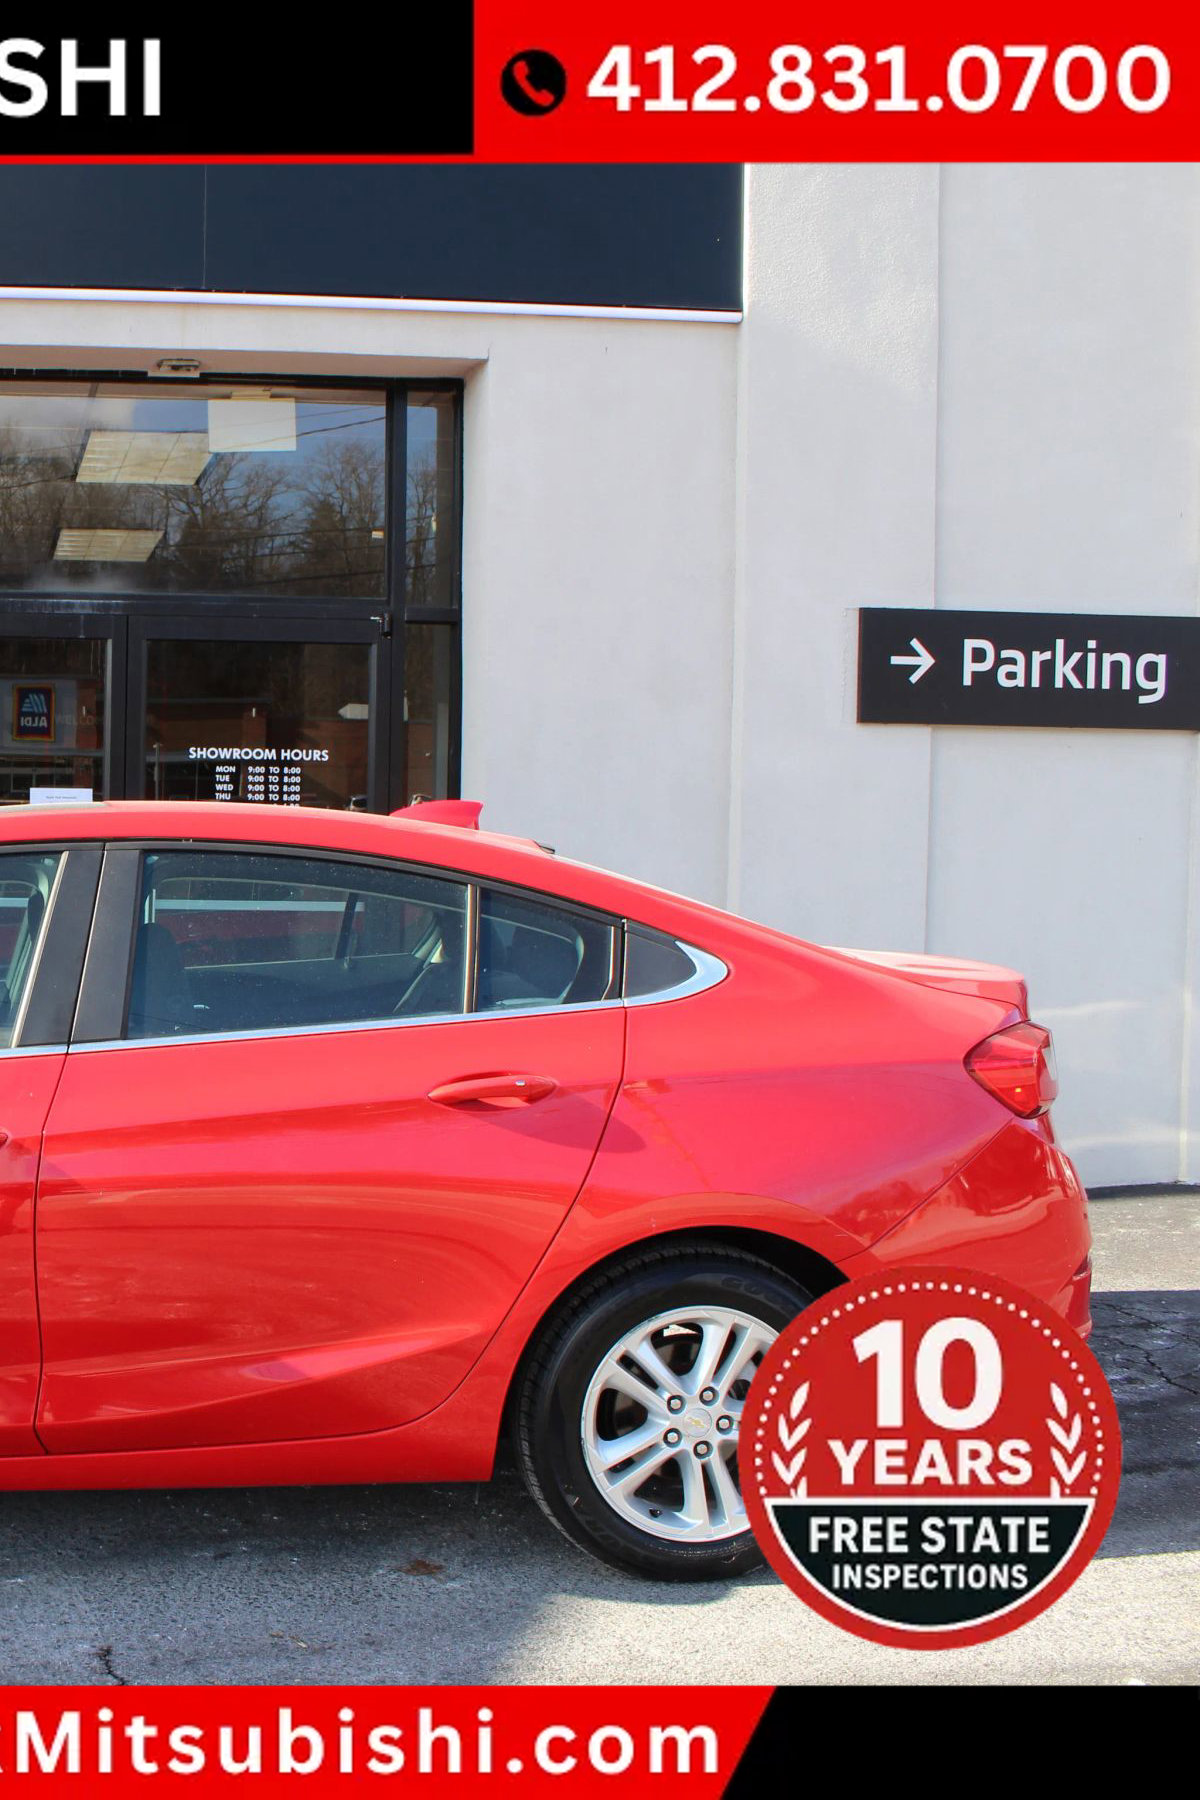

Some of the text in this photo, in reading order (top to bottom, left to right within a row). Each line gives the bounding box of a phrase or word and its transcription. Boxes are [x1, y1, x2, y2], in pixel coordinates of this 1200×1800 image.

[962, 638, 1167, 704] Parking
[188, 747, 329, 761] SHOWROOM HOURS
[215, 765, 236, 773] MON
[247, 766, 266, 774] 9:00
[247, 775, 265, 783] 9:00
[283, 776, 301, 784] 8:00
[282, 785, 301, 793] 8:00
[247, 793, 265, 801] 9:00
[282, 794, 301, 802] 8:00
